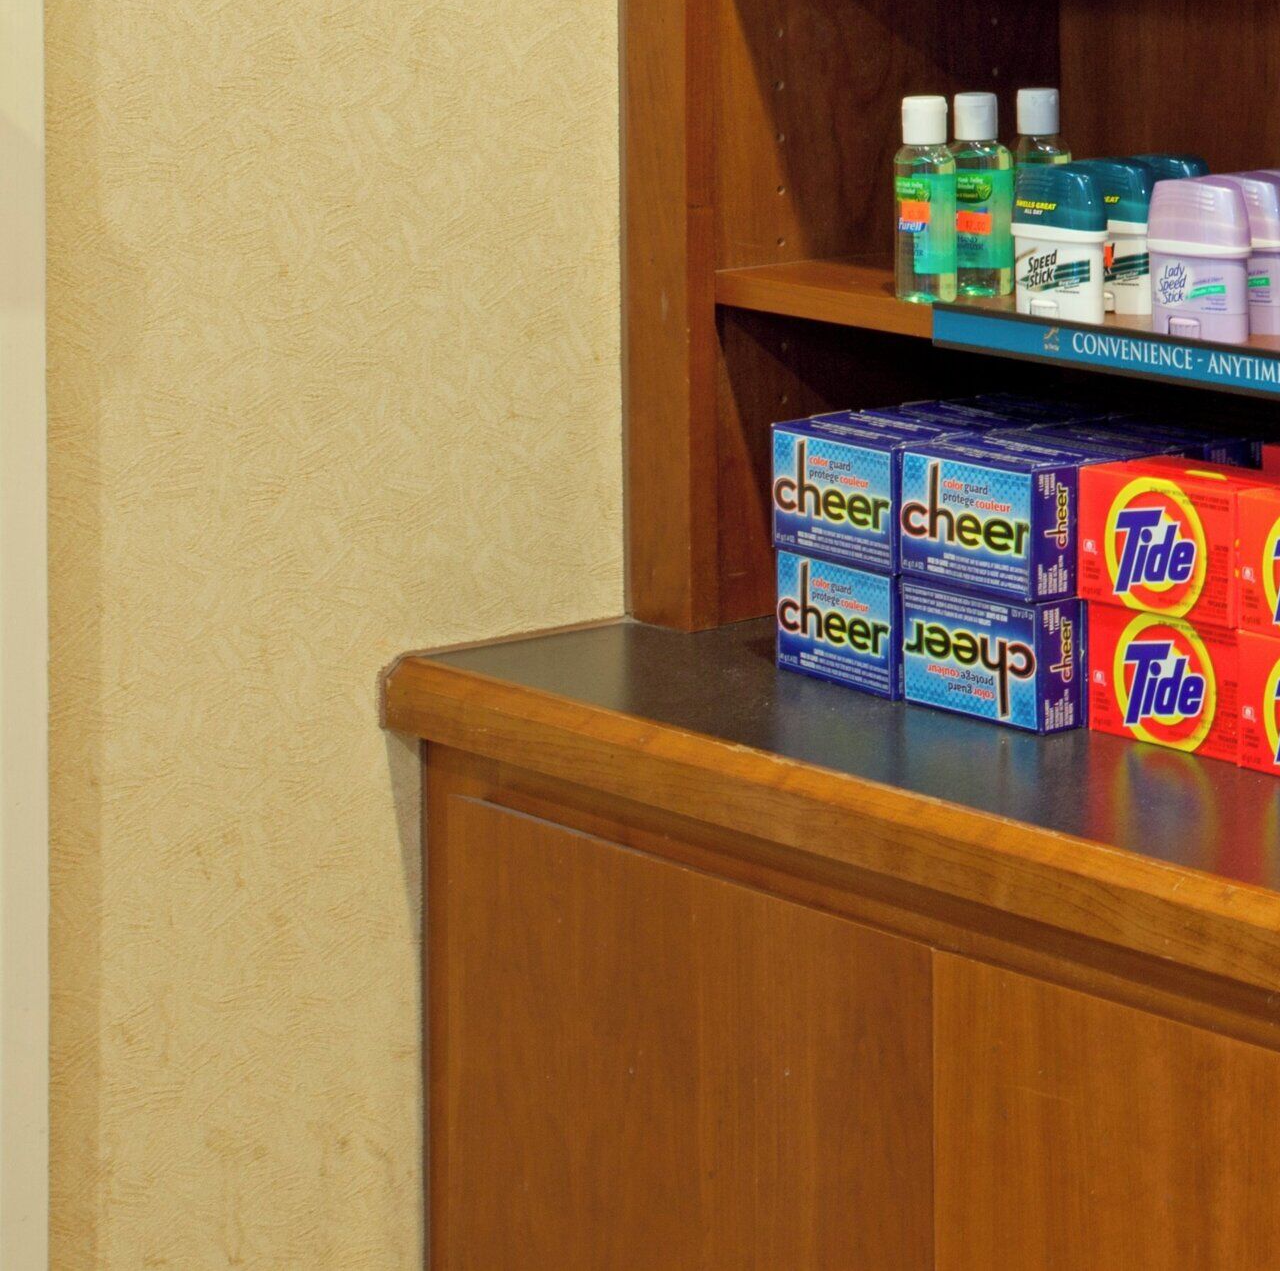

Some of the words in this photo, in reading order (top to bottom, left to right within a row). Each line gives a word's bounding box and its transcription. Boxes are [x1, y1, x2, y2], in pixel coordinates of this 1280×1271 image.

[1036, 201, 1057, 211] GREAT
[1159, 277, 1187, 292] Speed
[1162, 291, 1184, 304] Stick
[1164, 264, 1184, 278] Lady
[1072, 333, 1193, 371] CONVENIENCE
[773, 438, 890, 531] cheer
[808, 455, 828, 467] color
[828, 460, 851, 472] guard
[809, 468, 839, 483] protege
[839, 475, 869, 488] couleur
[900, 461, 1030, 556] cheer
[1043, 482, 1069, 550] cheer
[1112, 506, 1197, 596] Tide
[778, 560, 890, 655] cheer
[904, 620, 1037, 718] cheer
[1049, 617, 1072, 682] cheer
[1122, 639, 1206, 727] Tide
